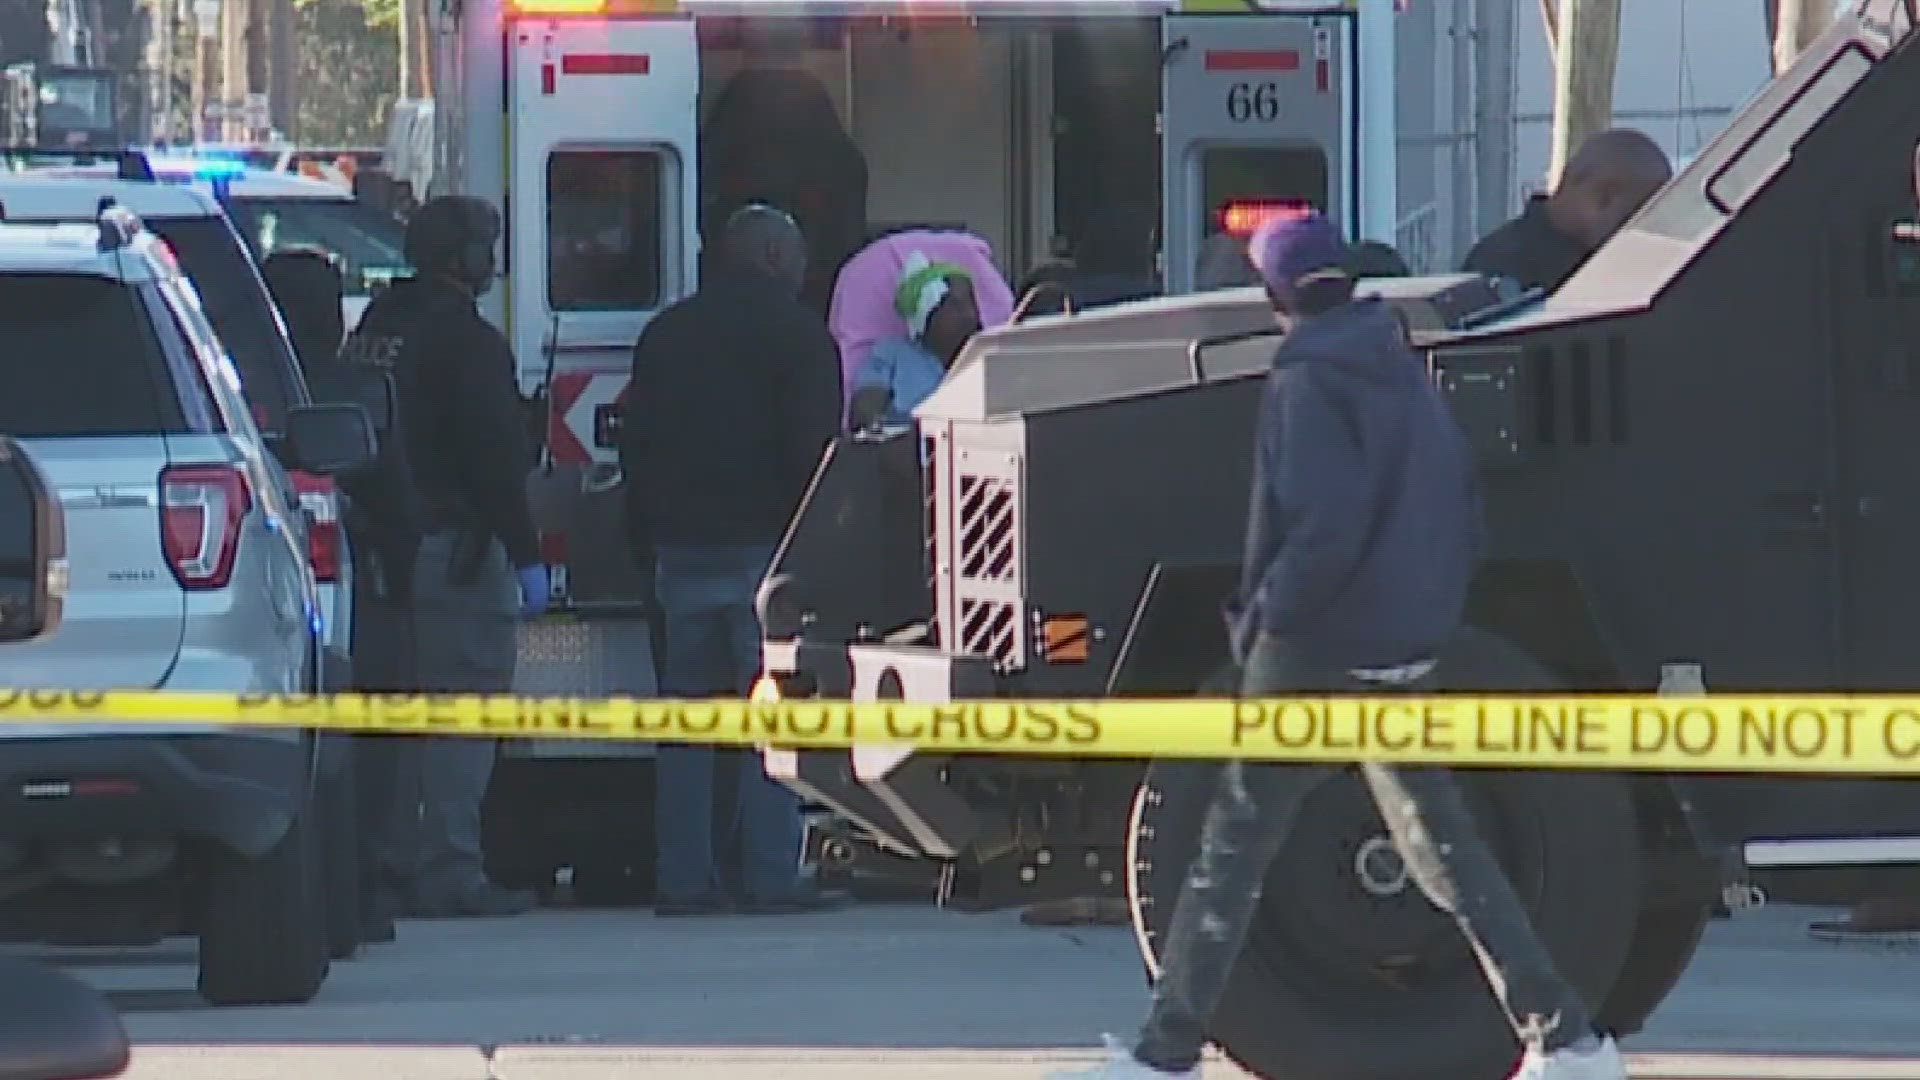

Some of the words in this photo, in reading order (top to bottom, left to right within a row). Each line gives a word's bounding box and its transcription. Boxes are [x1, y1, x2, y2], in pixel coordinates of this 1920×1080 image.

[1227, 81, 1279, 124] 66
[883, 702, 1103, 742] CROSS
[1230, 701, 1457, 749] POLICE
[1475, 703, 1610, 753] LINE
[1629, 705, 1720, 757] DO
[1737, 705, 1867, 759] NOT
